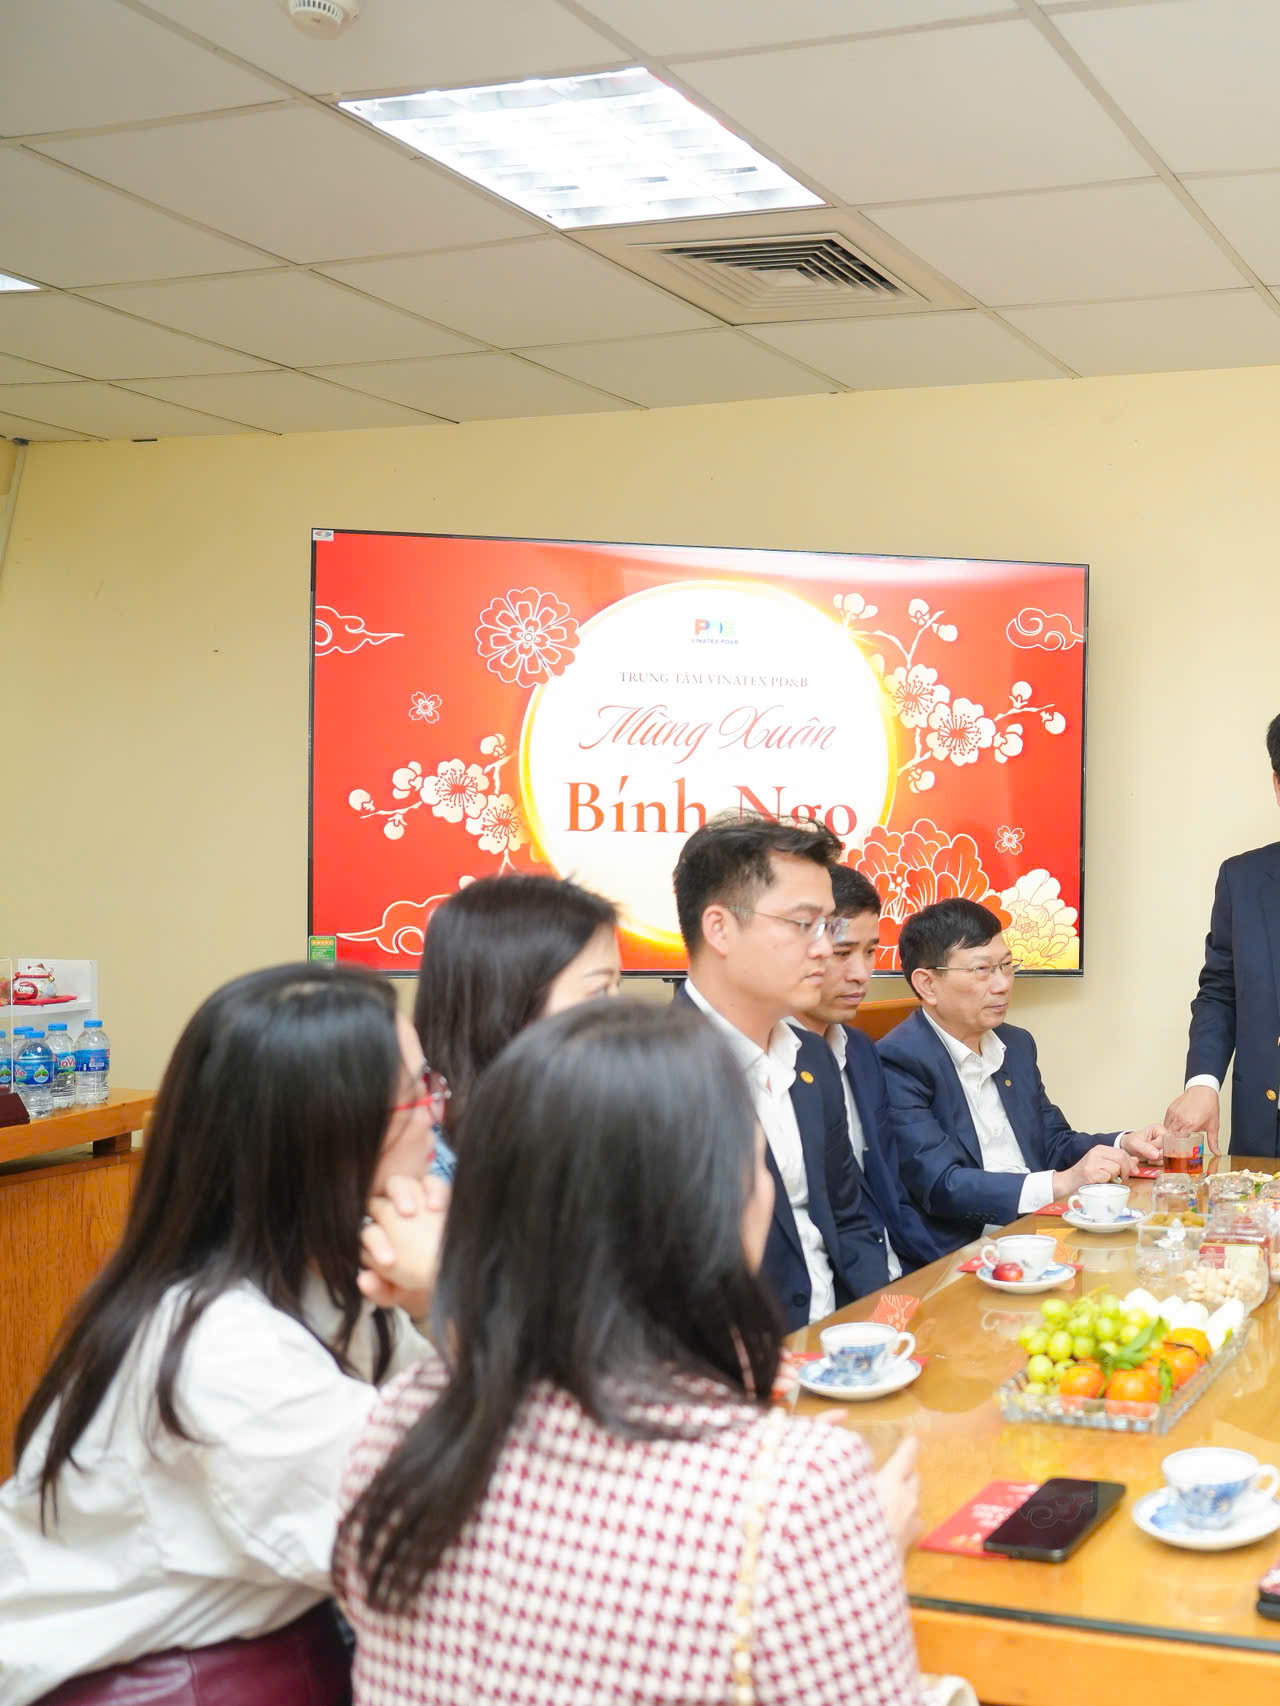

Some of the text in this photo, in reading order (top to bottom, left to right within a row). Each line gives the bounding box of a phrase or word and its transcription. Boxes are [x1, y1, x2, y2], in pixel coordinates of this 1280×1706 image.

[618, 671, 809, 688] TRUNG TÂM VINATEX PD&B
[578, 704, 837, 765] Mừng Xuân
[564, 775, 706, 834] Bính
